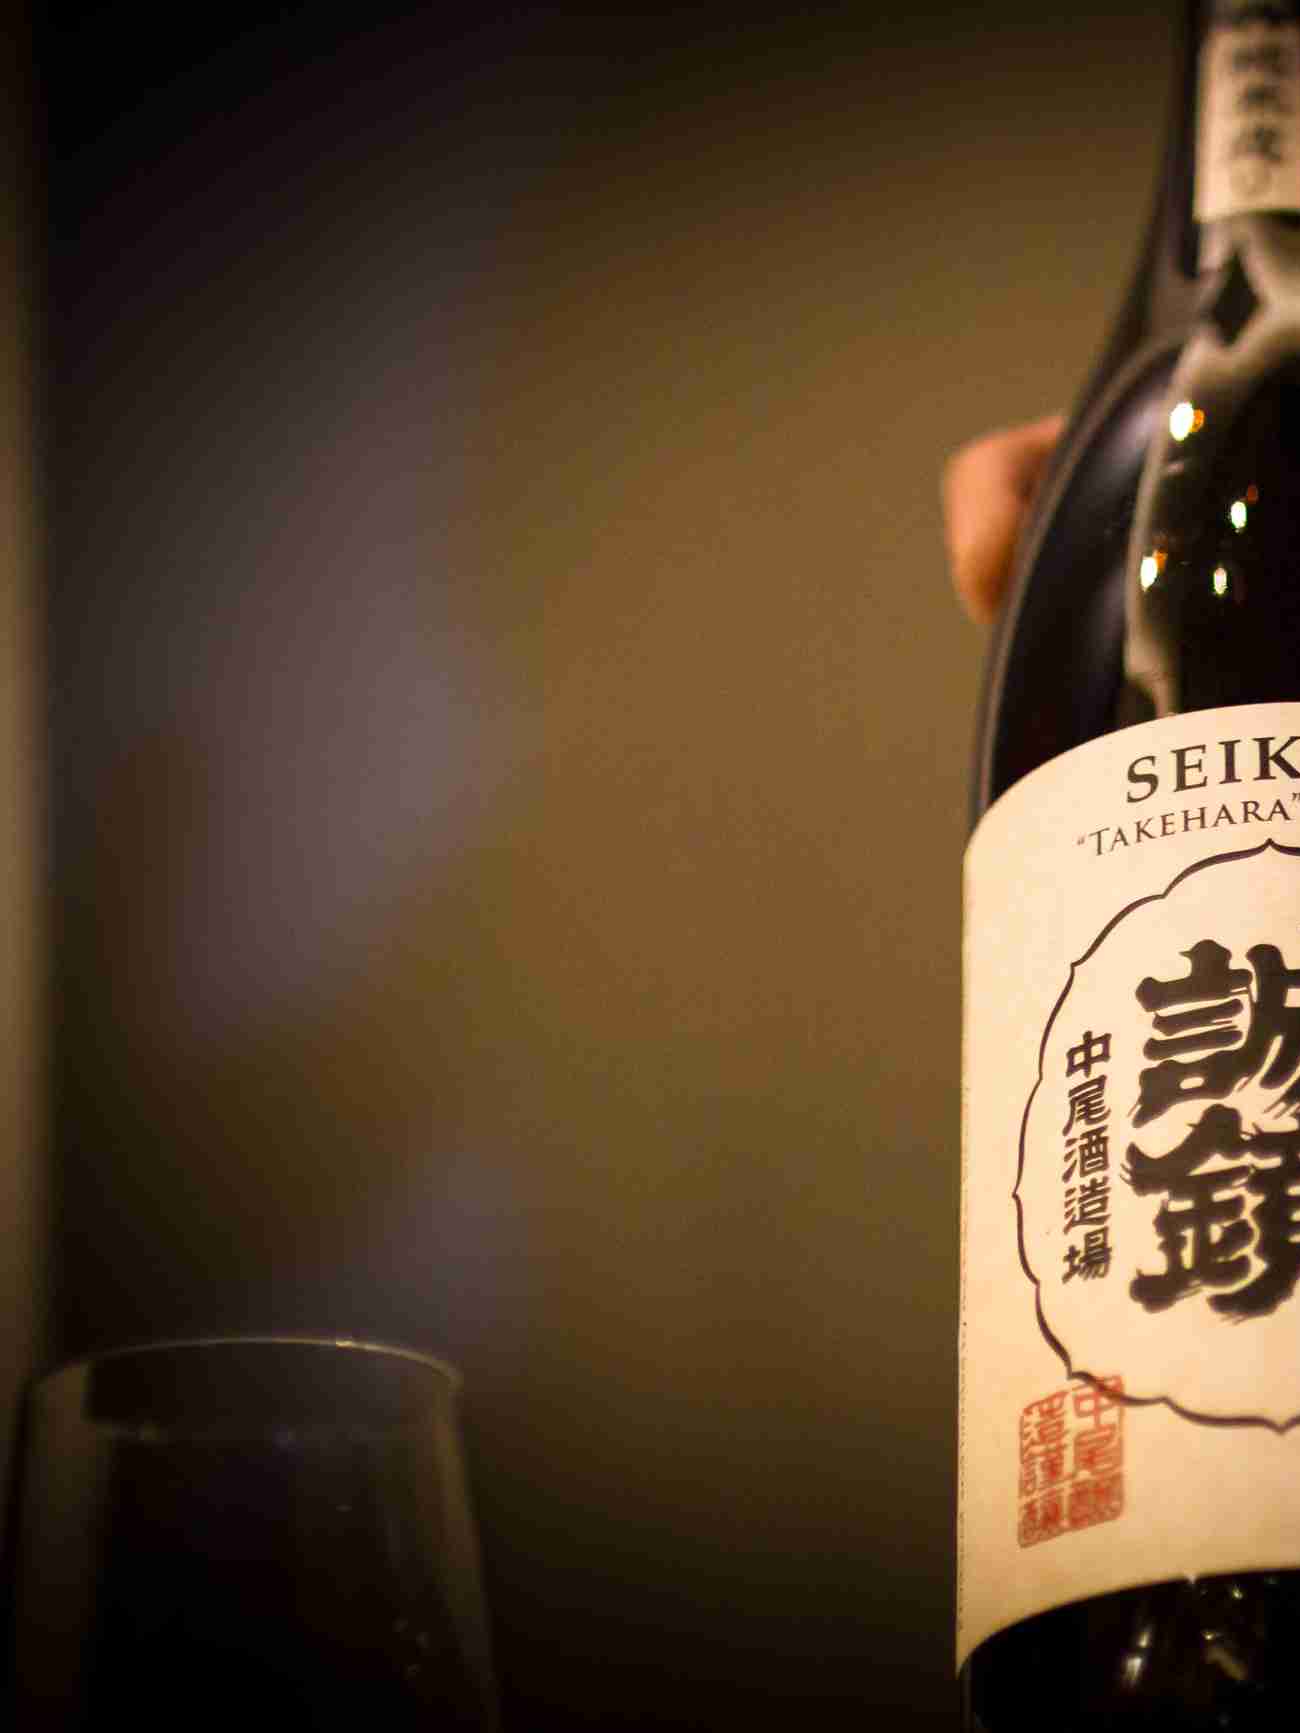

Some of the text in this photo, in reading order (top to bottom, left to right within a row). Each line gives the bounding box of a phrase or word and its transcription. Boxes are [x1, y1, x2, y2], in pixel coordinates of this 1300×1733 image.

[1062, 1030, 1113, 1284] 中尾酒造場
